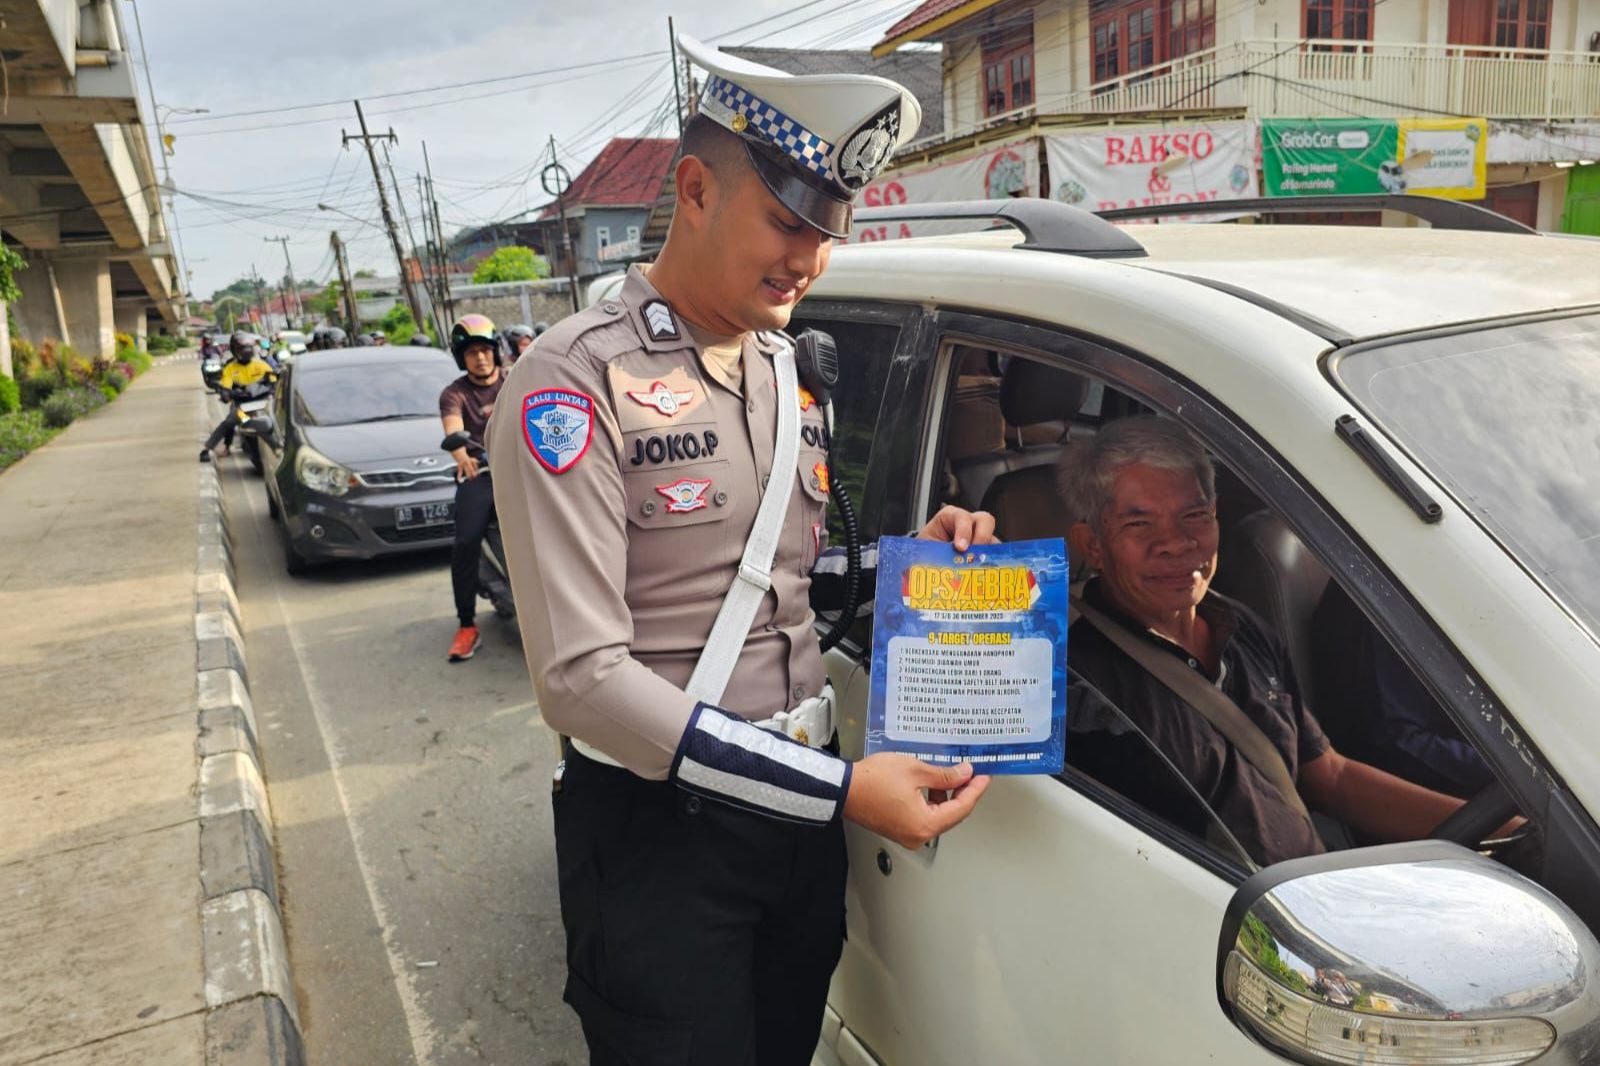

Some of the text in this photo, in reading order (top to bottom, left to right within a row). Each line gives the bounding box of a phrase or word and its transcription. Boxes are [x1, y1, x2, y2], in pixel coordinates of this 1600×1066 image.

[1104, 131, 1214, 166] BAKSO
[1281, 131, 1336, 149] GrabCar
[1147, 166, 1171, 194] &
[528, 392, 589, 408] LALU LINTAS
[630, 430, 719, 466] JOKO.P
[909, 566, 1031, 601] OPS ZEBRA
[909, 598, 1030, 610] MAHAKAM
[961, 612, 989, 620] NOVEMBER
[928, 631, 1012, 645] 9 TARGET OPERASI
